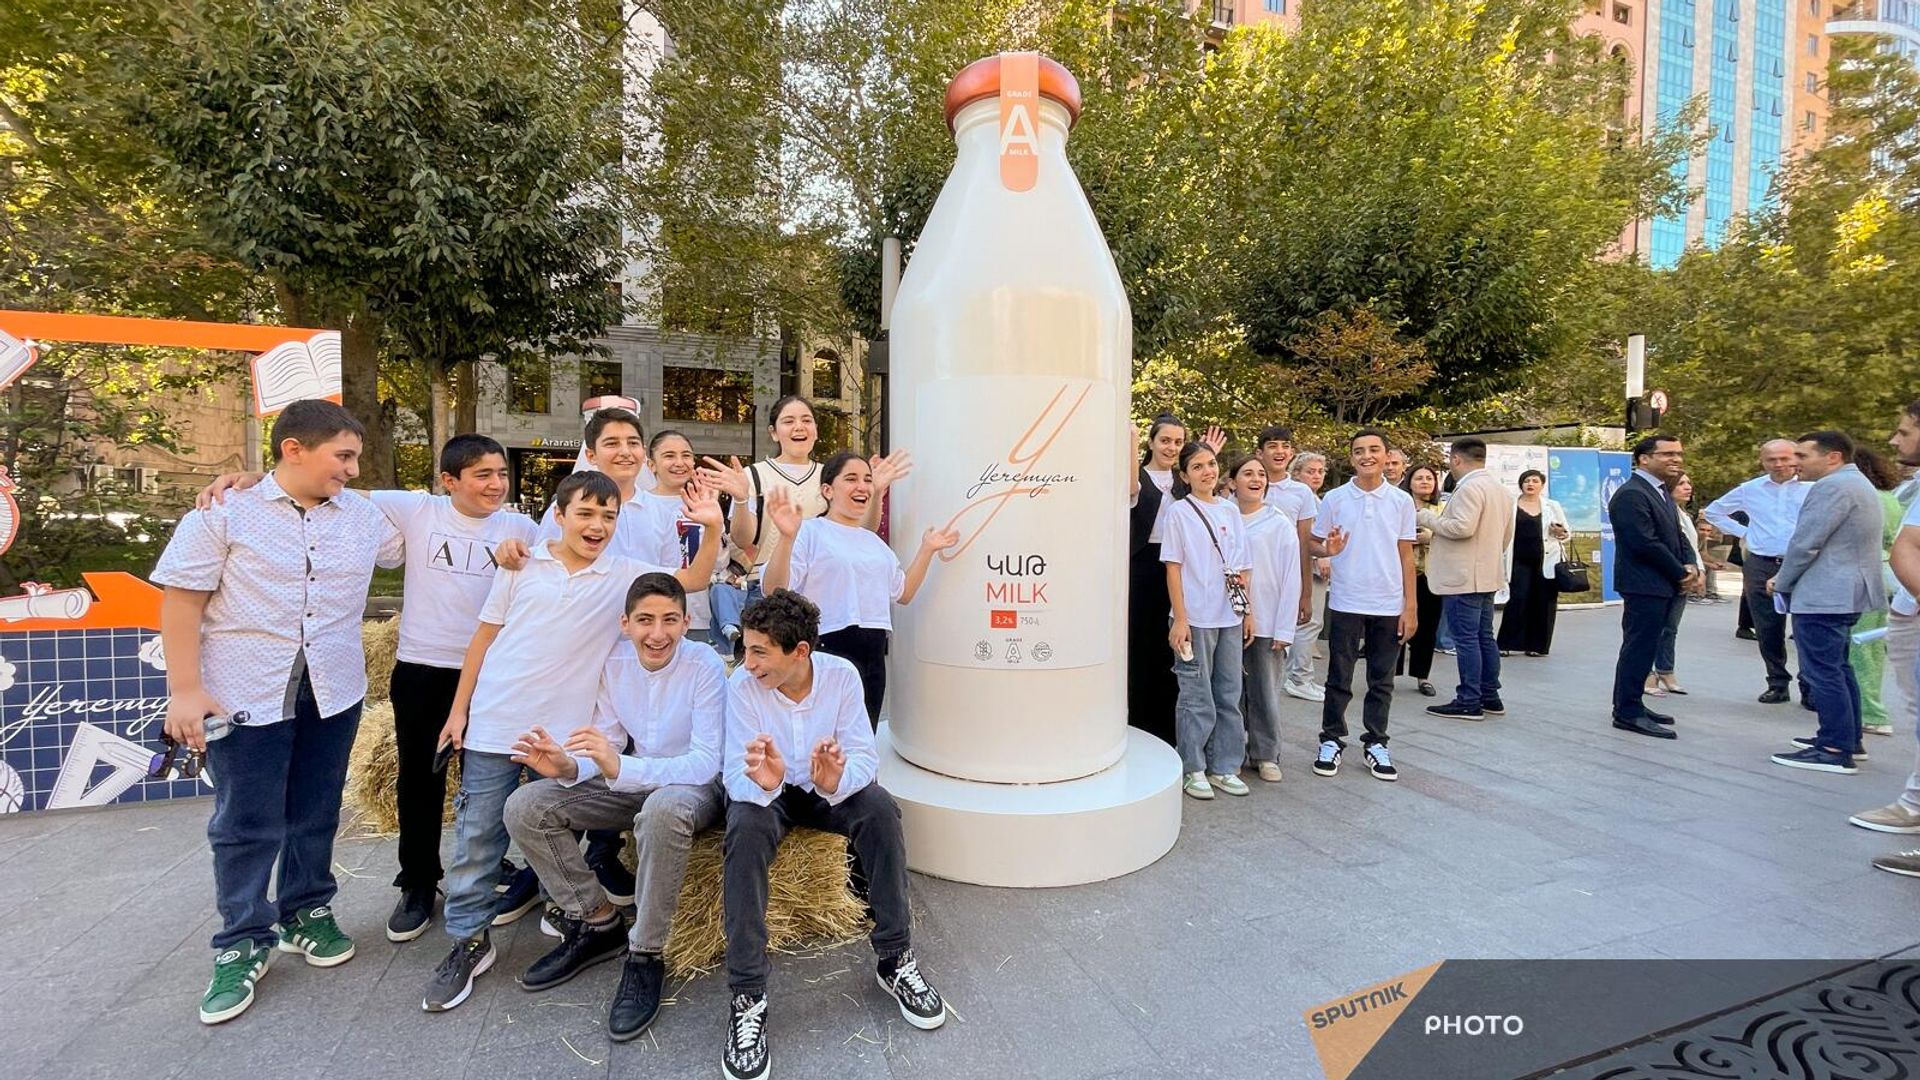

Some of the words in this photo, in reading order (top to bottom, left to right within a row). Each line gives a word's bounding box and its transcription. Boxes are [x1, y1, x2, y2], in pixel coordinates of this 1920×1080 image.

[1000, 104, 1038, 156] A
[541, 438, 581, 448] AraratB
[966, 463, 1078, 499] Yeremyan
[987, 554, 1047, 577] ԿԱԹ
[986, 582, 1048, 604] MILK
[0, 684, 173, 745] Yeremy
